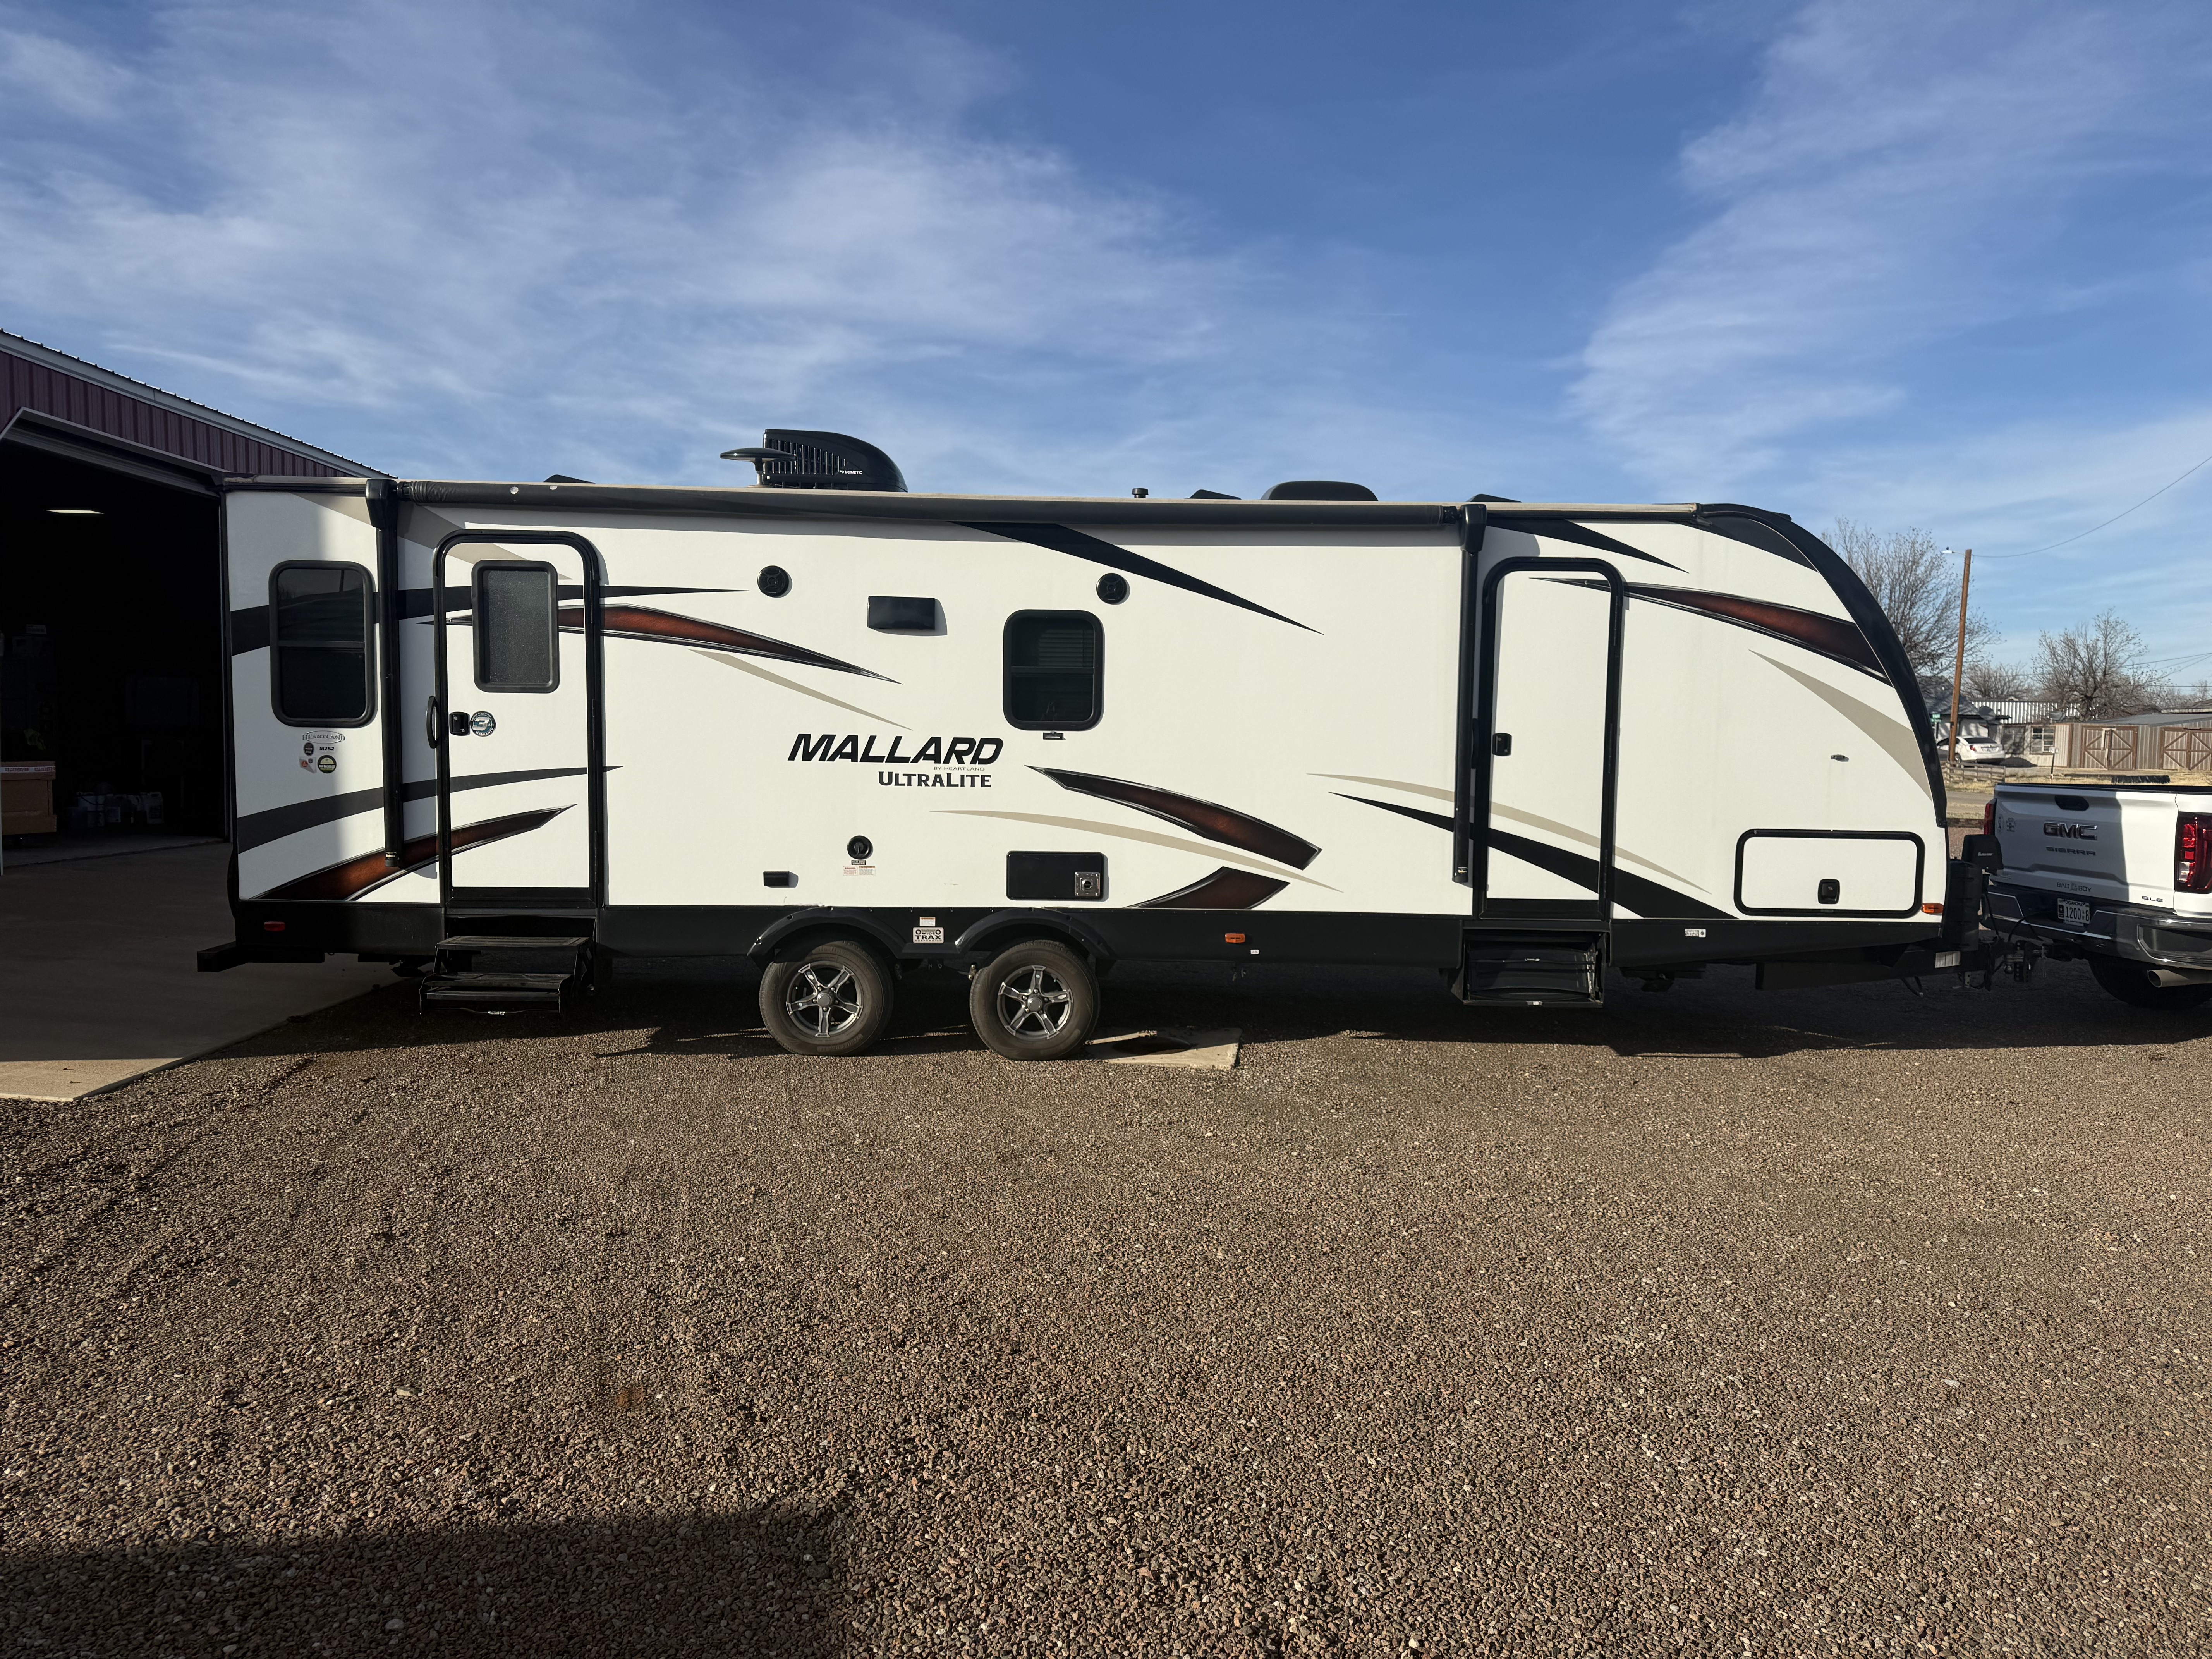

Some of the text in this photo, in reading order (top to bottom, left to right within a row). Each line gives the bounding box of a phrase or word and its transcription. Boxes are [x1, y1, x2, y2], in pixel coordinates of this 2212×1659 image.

[472, 717, 489, 731] 3
[787, 733, 1004, 766] MALLARD
[2043, 821, 2097, 841] GMC
[2045, 847, 2096, 856] SIERRA
[2066, 906, 2081, 920] 1200
[2085, 910, 2089, 921] 8
